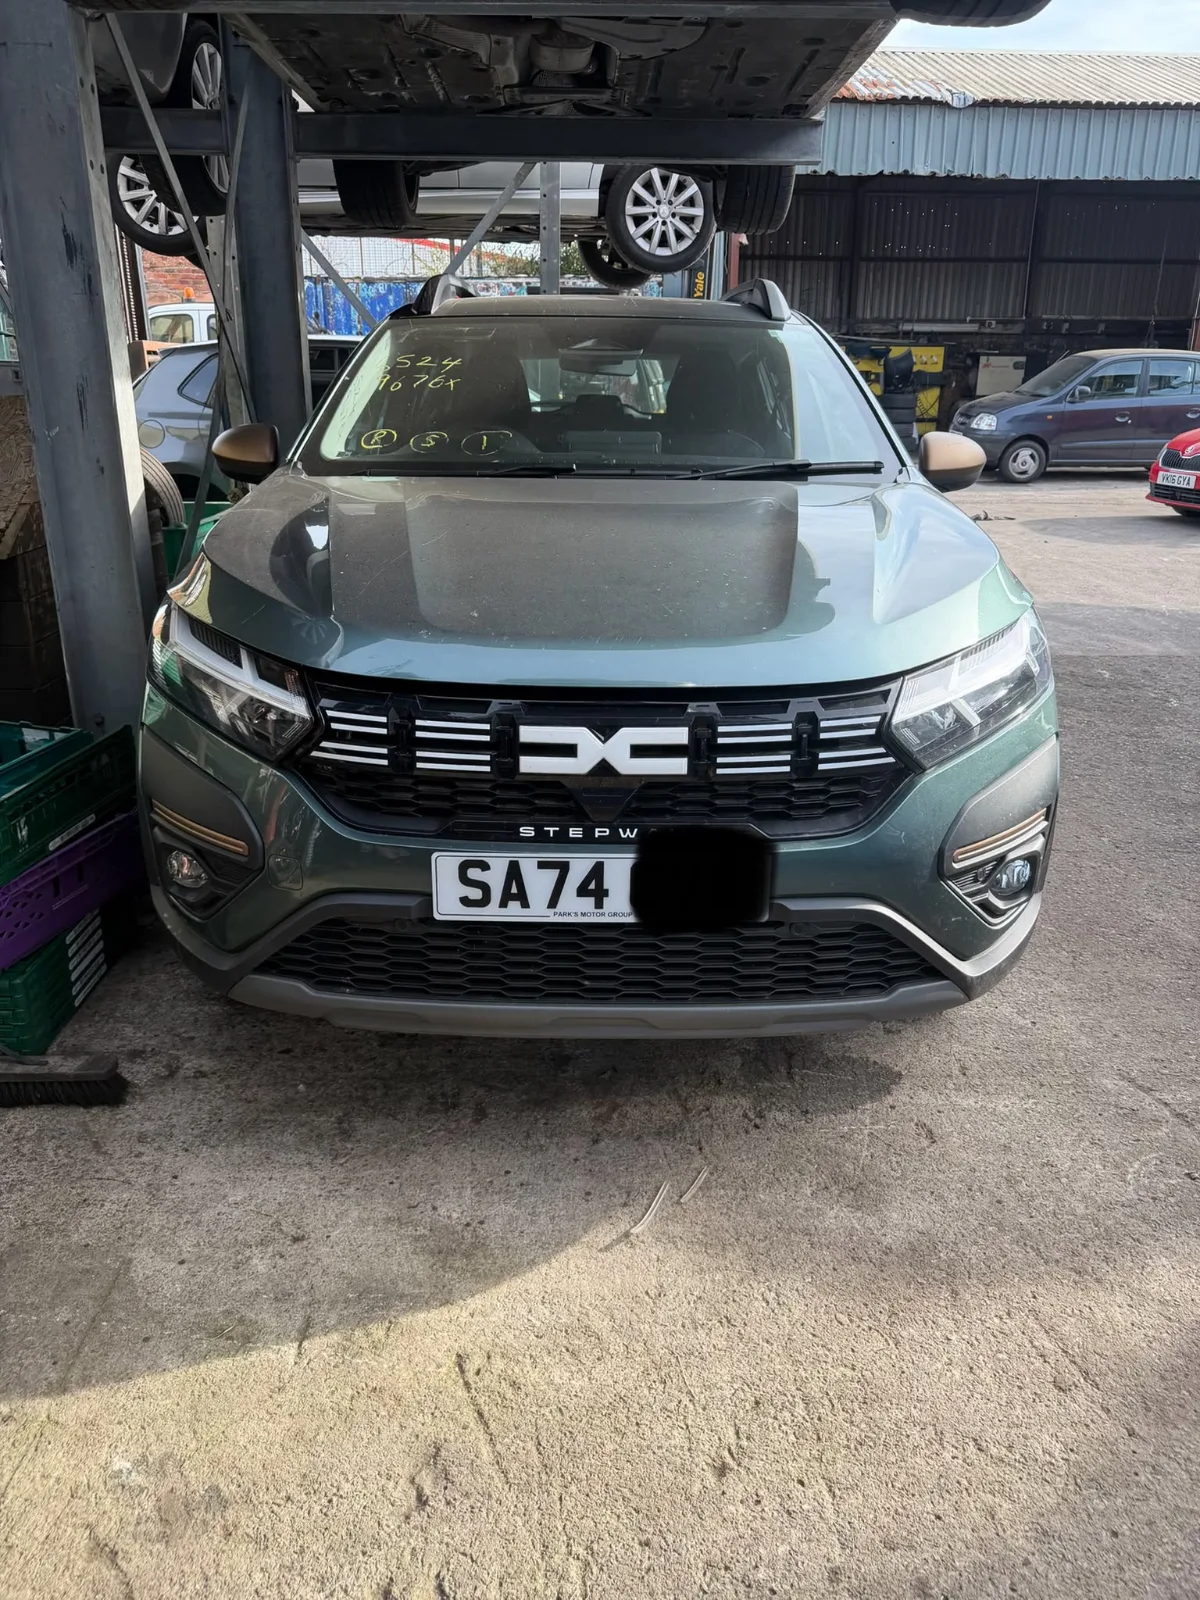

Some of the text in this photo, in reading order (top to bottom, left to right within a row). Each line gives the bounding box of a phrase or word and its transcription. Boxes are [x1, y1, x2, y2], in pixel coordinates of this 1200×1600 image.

[693, 271, 705, 298] Yale
[1161, 473, 1192, 487] VK16 GYA
[519, 826, 657, 839] STEPW
[457, 858, 610, 910] SA74
[607, 911, 634, 919] GROUP
